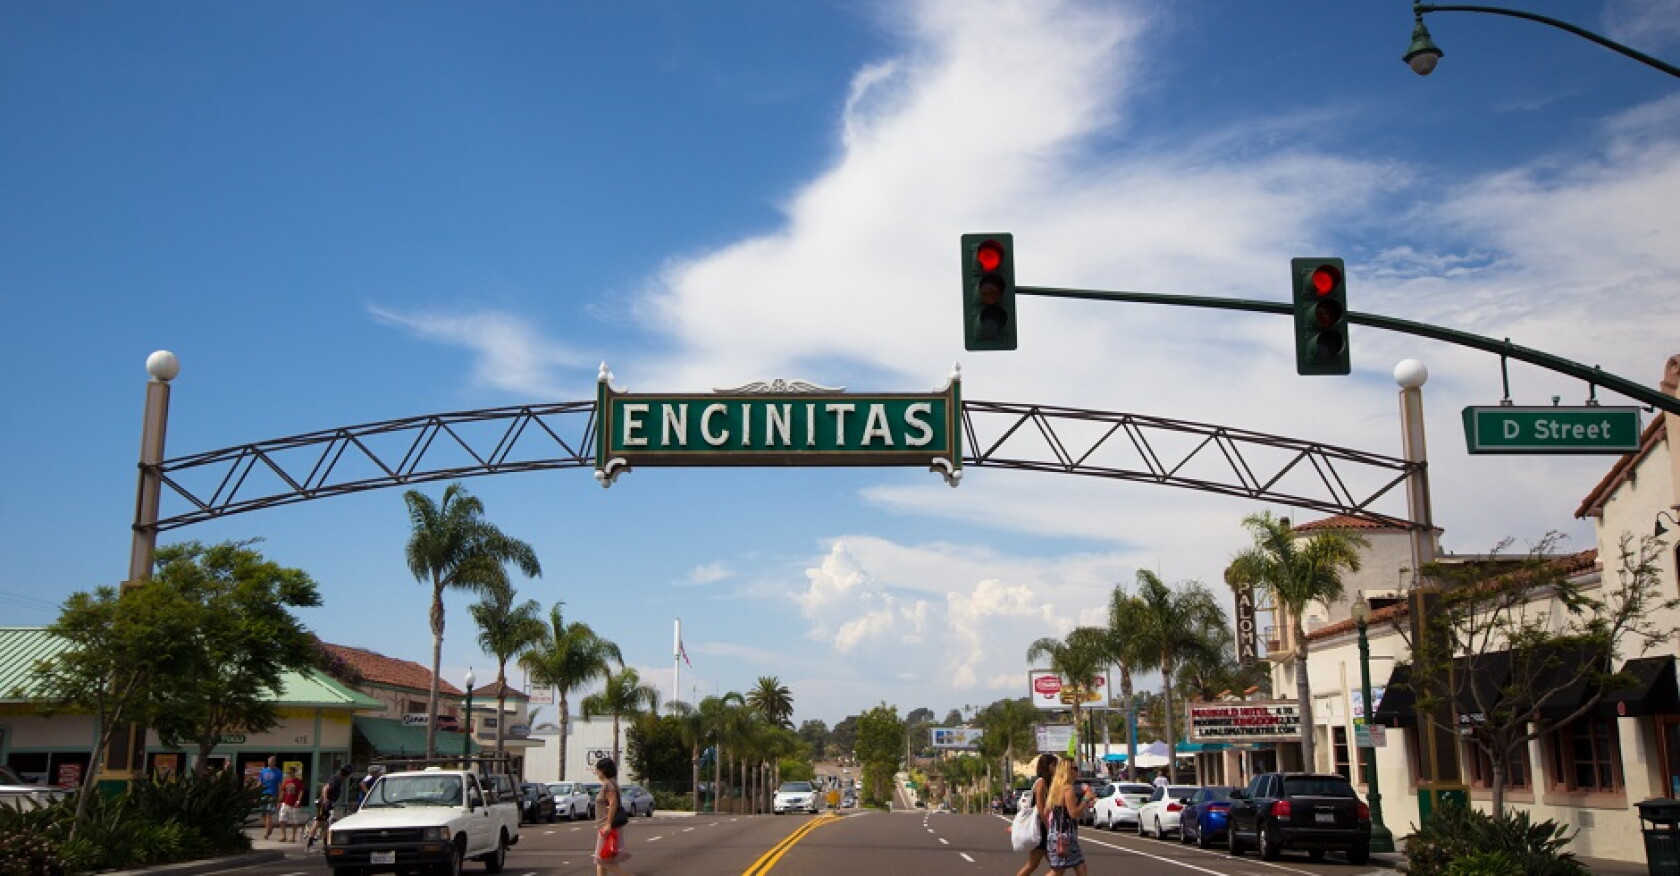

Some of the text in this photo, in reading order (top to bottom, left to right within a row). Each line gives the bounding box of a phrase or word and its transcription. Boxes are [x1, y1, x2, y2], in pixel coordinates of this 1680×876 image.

[622, 402, 934, 446] ENCINITAS
[1502, 419, 1611, 439] D Street
[1238, 582, 1254, 657] PALOMA
[1233, 716, 1279, 726] KINGDOM
